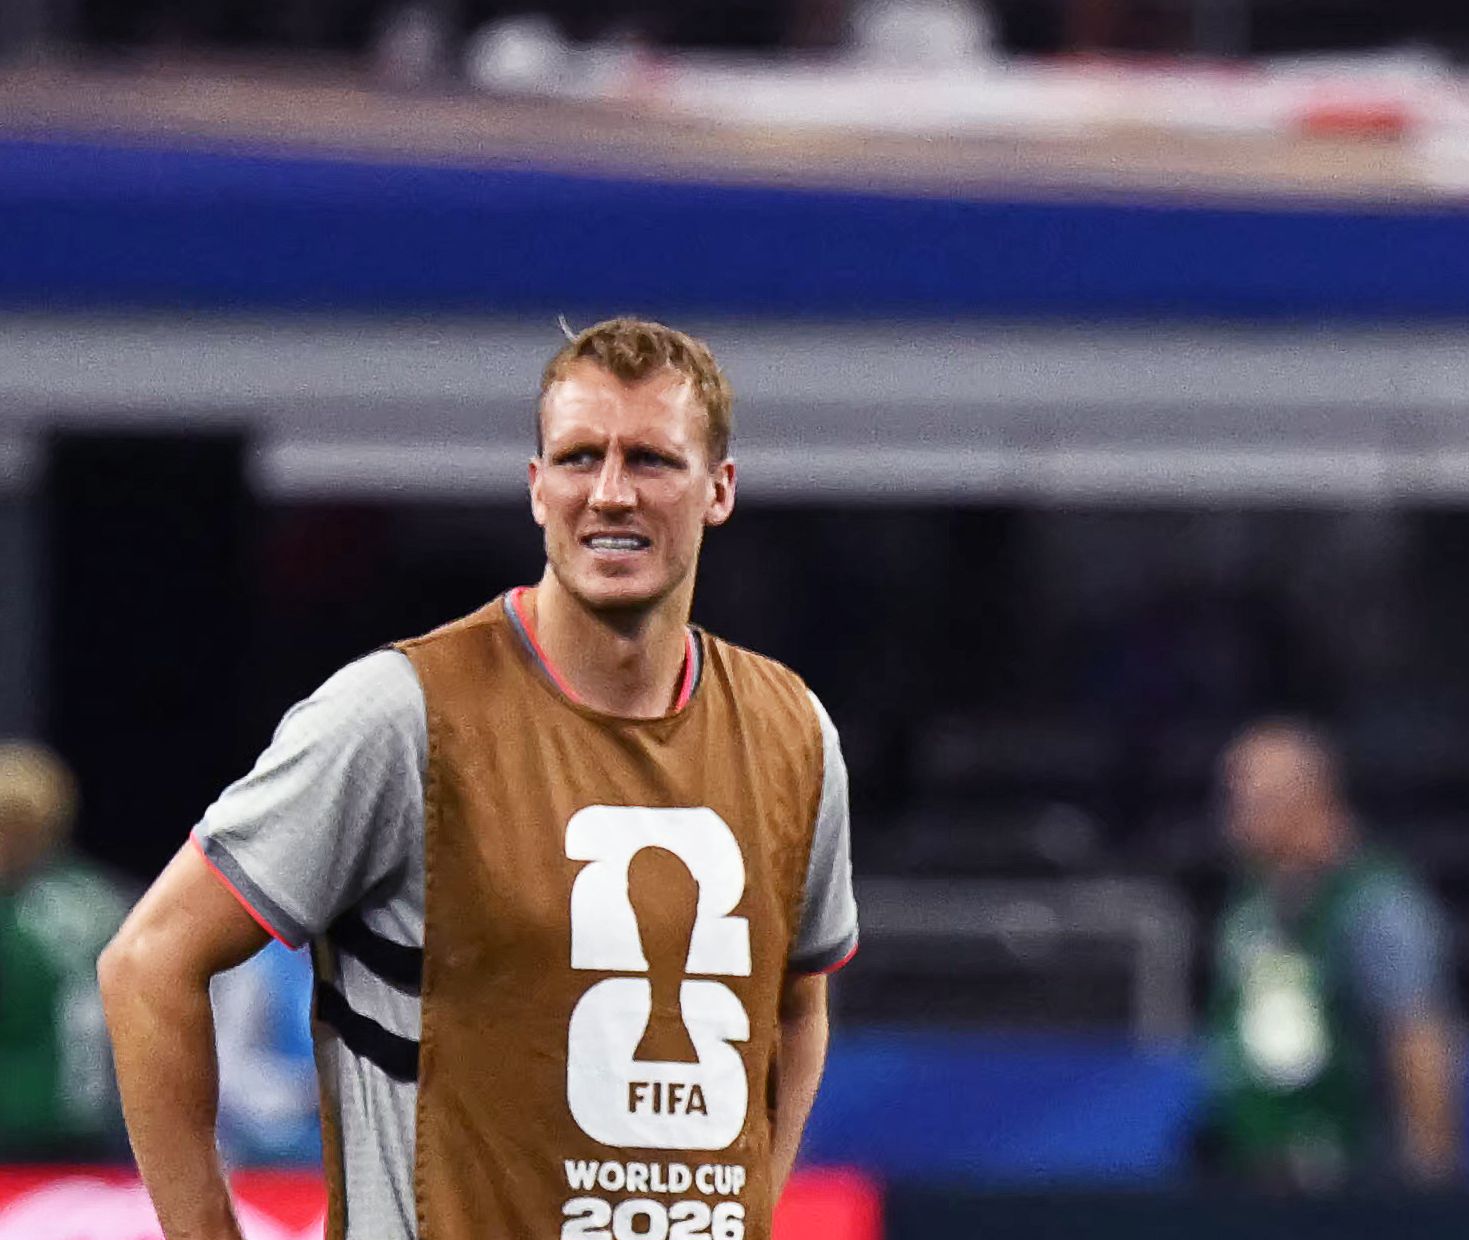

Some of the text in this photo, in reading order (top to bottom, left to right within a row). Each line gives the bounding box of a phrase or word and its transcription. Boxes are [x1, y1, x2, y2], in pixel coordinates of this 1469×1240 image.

[628, 1081, 708, 1116] FIFA
[564, 1160, 746, 1196] WORLD CUP
